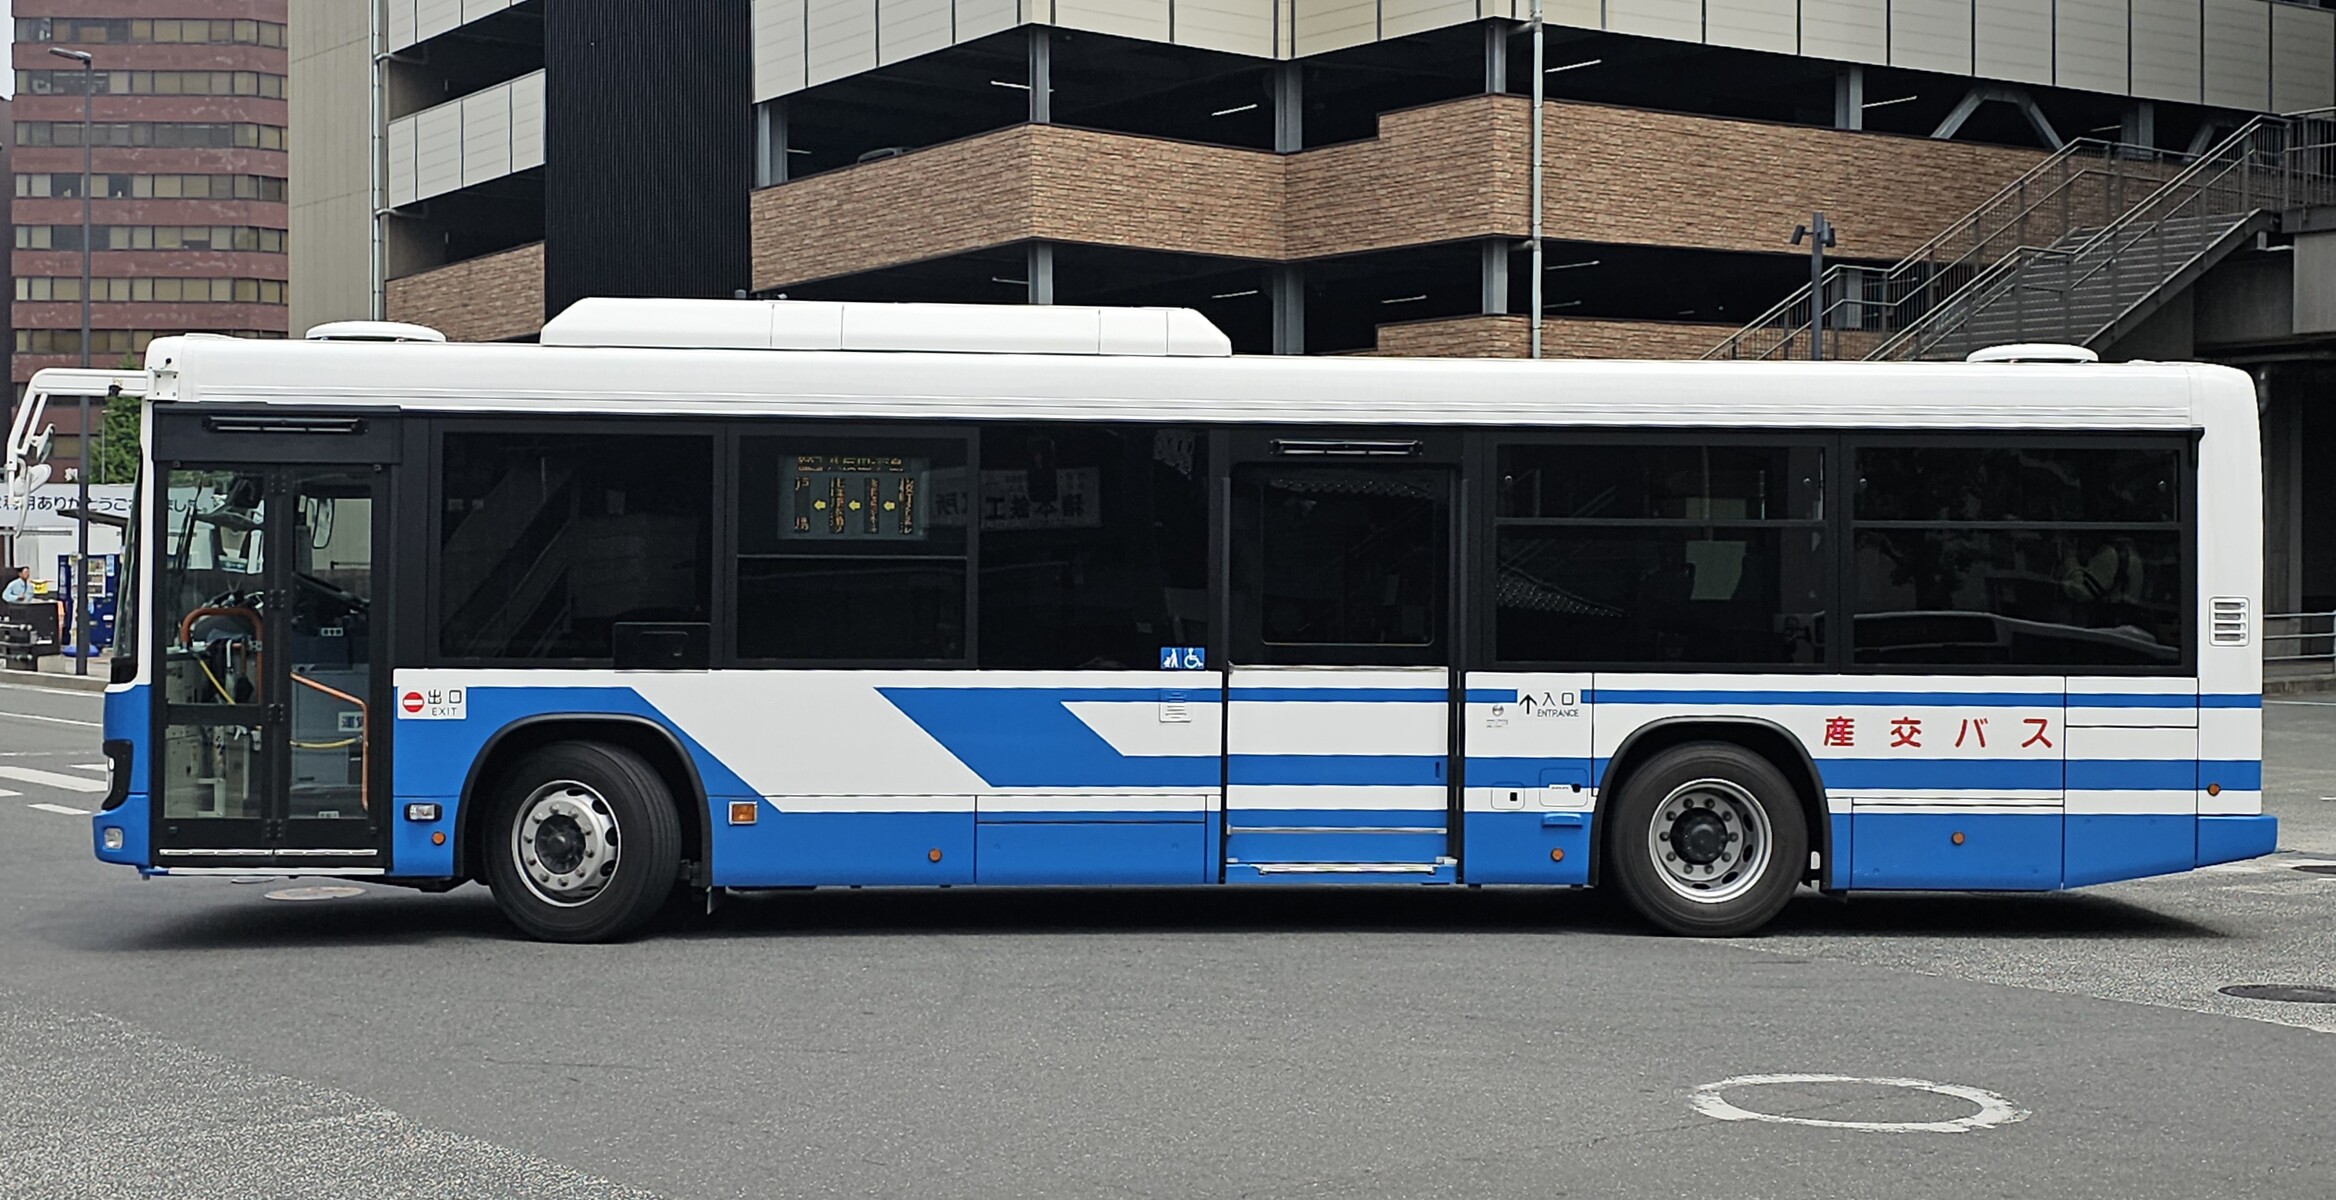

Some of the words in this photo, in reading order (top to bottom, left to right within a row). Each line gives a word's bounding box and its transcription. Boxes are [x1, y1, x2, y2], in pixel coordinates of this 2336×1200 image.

[427, 689, 462, 704] 出口
[1542, 692, 1574, 706] 入口
[432, 707, 457, 716] EXIT
[1537, 709, 1579, 717] ENTRANCE
[1823, 715, 2053, 750] 産交バス
